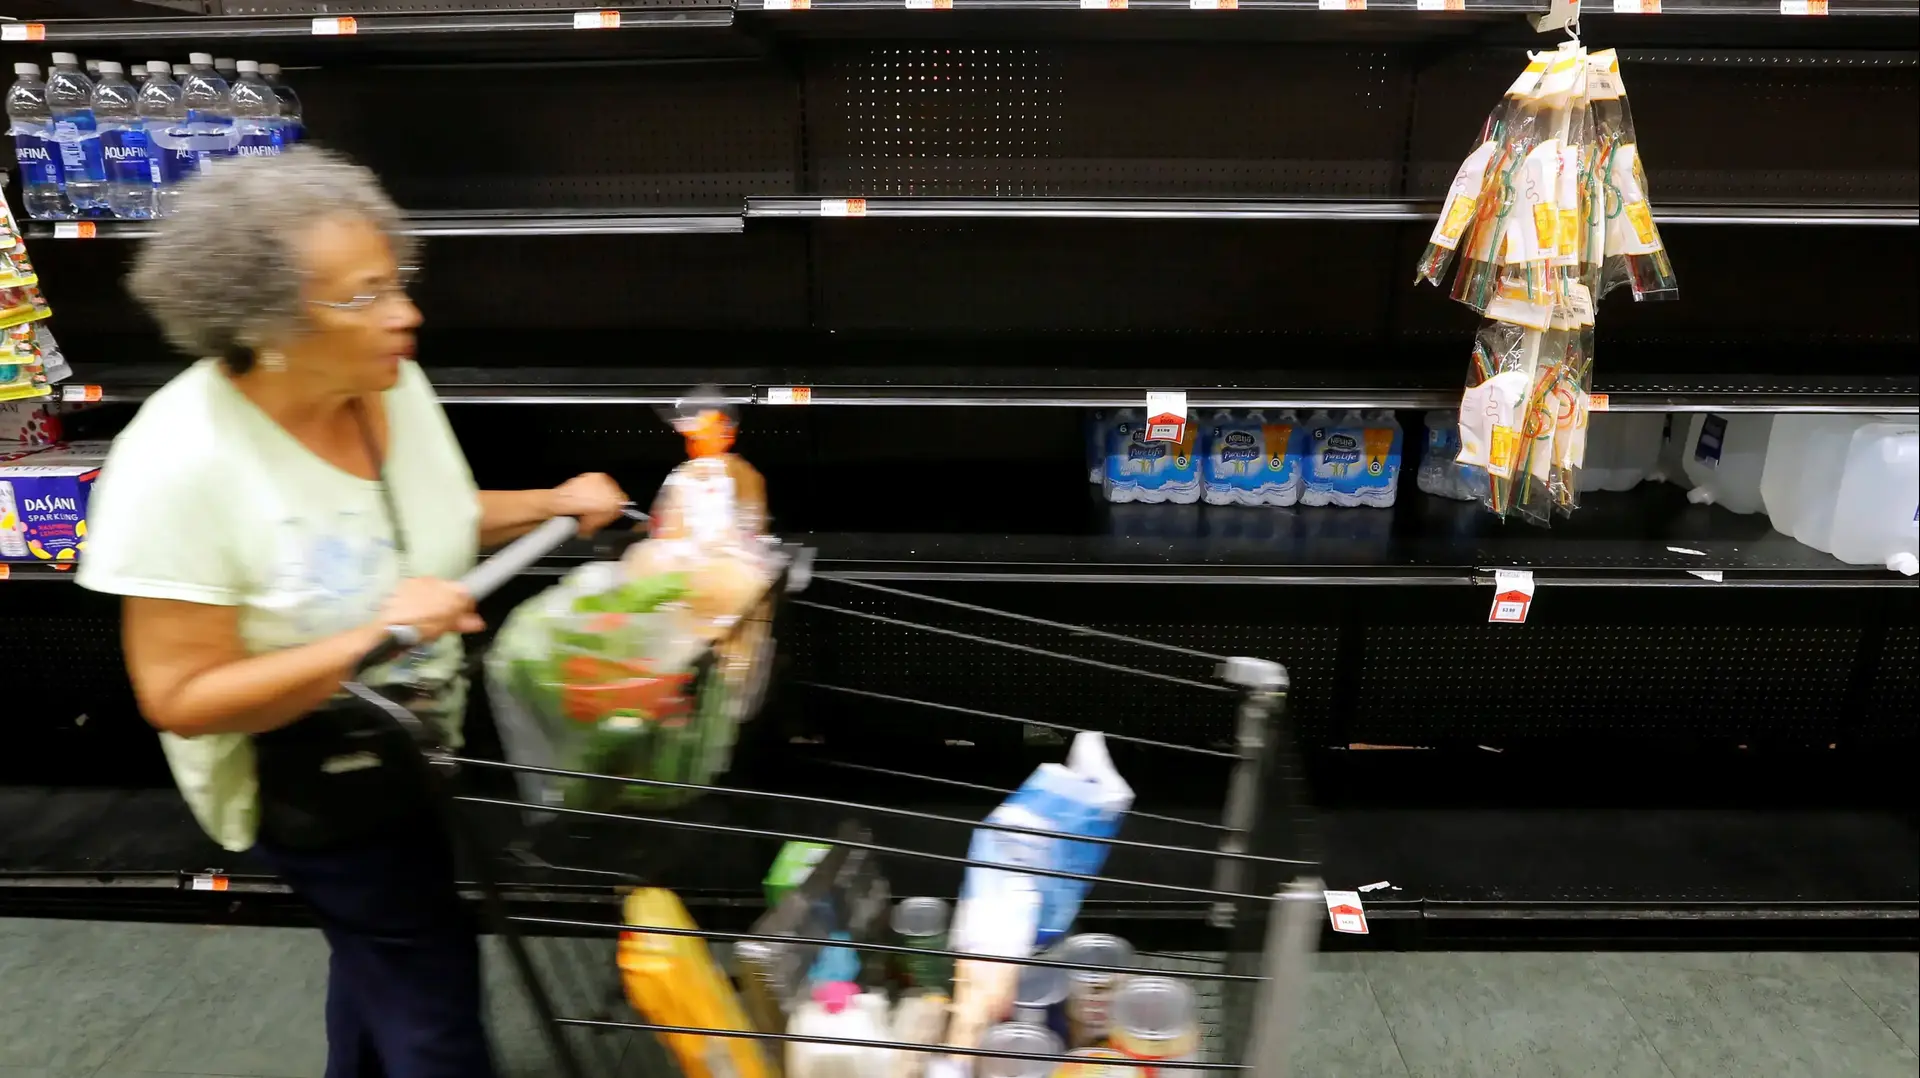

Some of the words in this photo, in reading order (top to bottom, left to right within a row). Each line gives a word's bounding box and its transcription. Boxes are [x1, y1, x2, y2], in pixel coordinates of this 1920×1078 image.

[17, 147, 51, 160] AFINA
[104, 146, 148, 160] AQUAFIN
[237, 144, 281, 157] QUAFINA
[1120, 424, 1127, 433] 6
[1315, 429, 1323, 438] 6
[1341, 452, 1357, 461] Life
[24, 494, 76, 513] DASANI
[28, 513, 79, 522] SPARKLING
